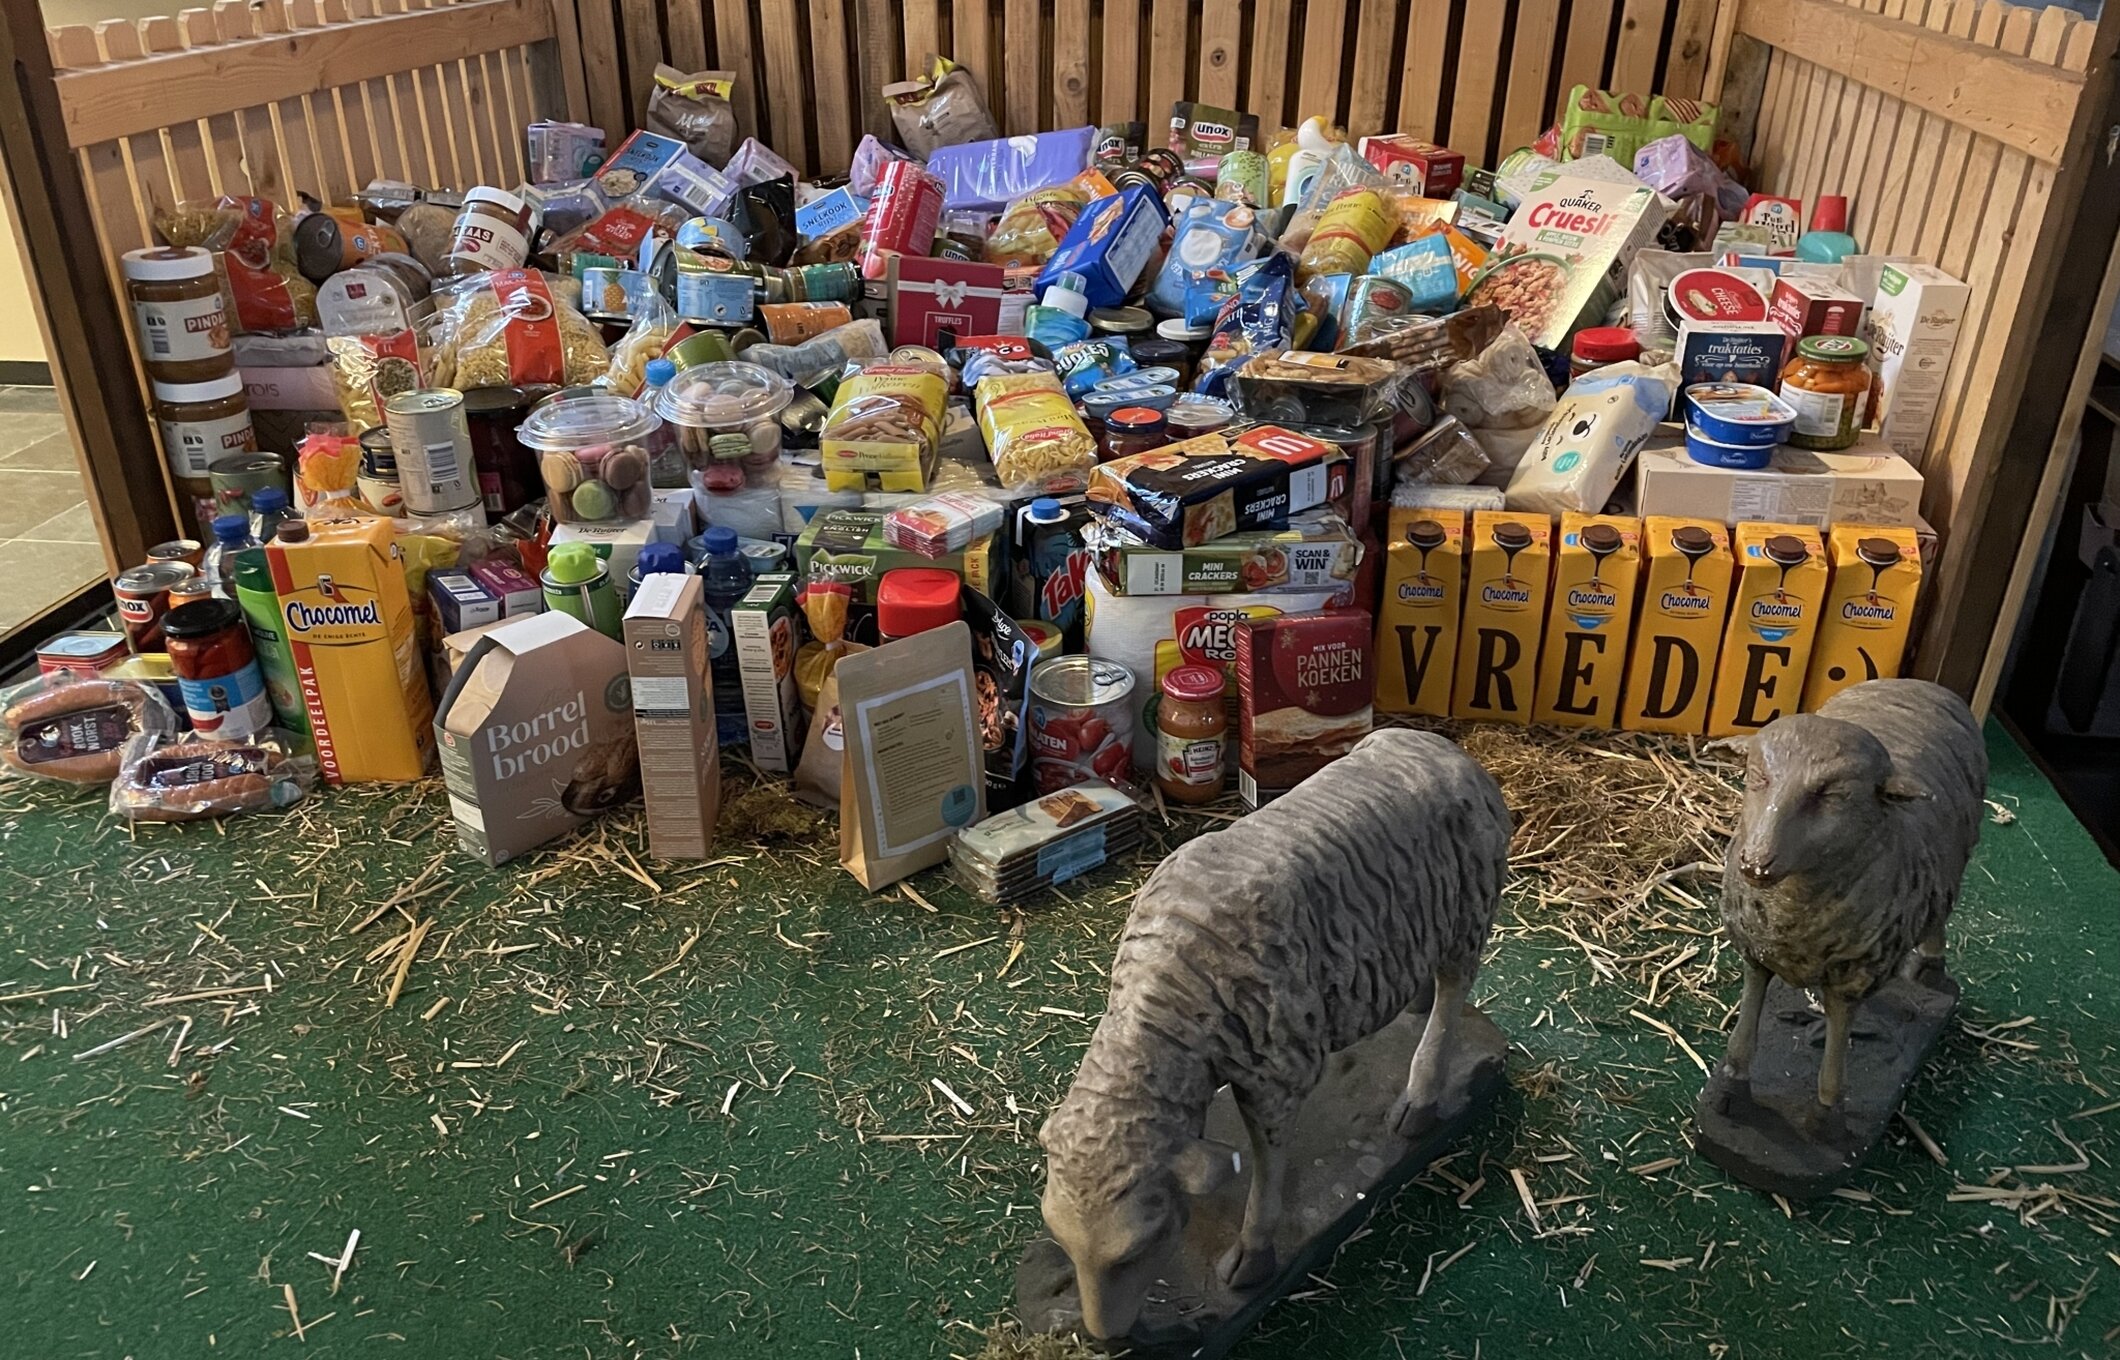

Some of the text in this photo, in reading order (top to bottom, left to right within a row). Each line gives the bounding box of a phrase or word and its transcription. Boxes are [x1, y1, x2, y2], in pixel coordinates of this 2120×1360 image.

[1197, 123, 1230, 137] unox
[1560, 198, 1602, 213] QUAKER
[802, 202, 847, 229] SNELKOOK
[1529, 203, 1619, 237] Cruesli
[1711, 287, 1740, 316] CHEESE
[934, 315, 963, 326] TRUFFLES
[1709, 343, 1762, 356] traktaties
[1258, 434, 1314, 456] LU
[1182, 458, 1247, 482] CRACKERS
[1212, 467, 1244, 481] MINI
[1245, 493, 1287, 515] CRACKERS
[827, 514, 881, 524] PICKWICK
[1256, 508, 1275, 522] MINI
[578, 527, 592, 535] De
[1295, 549, 1321, 558] SCAN
[810, 561, 873, 577] PICKWICK
[1202, 562, 1224, 571] MINI
[1295, 558, 1328, 570] WIN
[1188, 571, 1238, 581] CRACKERS
[1399, 583, 1444, 599] Chocomel
[1482, 586, 1529, 603] Chocomel
[1568, 590, 1616, 607] Chocomel
[1661, 592, 1710, 610] Chocomel
[1751, 600, 1802, 618] Chocomel
[286, 600, 382, 632] Chocomel
[1209, 609, 1249, 624] popla
[1842, 602, 1895, 620] Chocomel
[1205, 649, 1238, 661] RO
[1313, 641, 1346, 652] MIX VOOR
[1297, 649, 1362, 671] PANNEN
[1297, 665, 1362, 688] KOEKEN
[299, 666, 340, 779] VOORDEELPAK
[487, 690, 587, 751] Borrel
[71, 723, 84, 750] ROOK
[84, 717, 97, 751] WORST
[493, 718, 590, 781] brood
[1193, 744, 1215, 754] HEINZ
